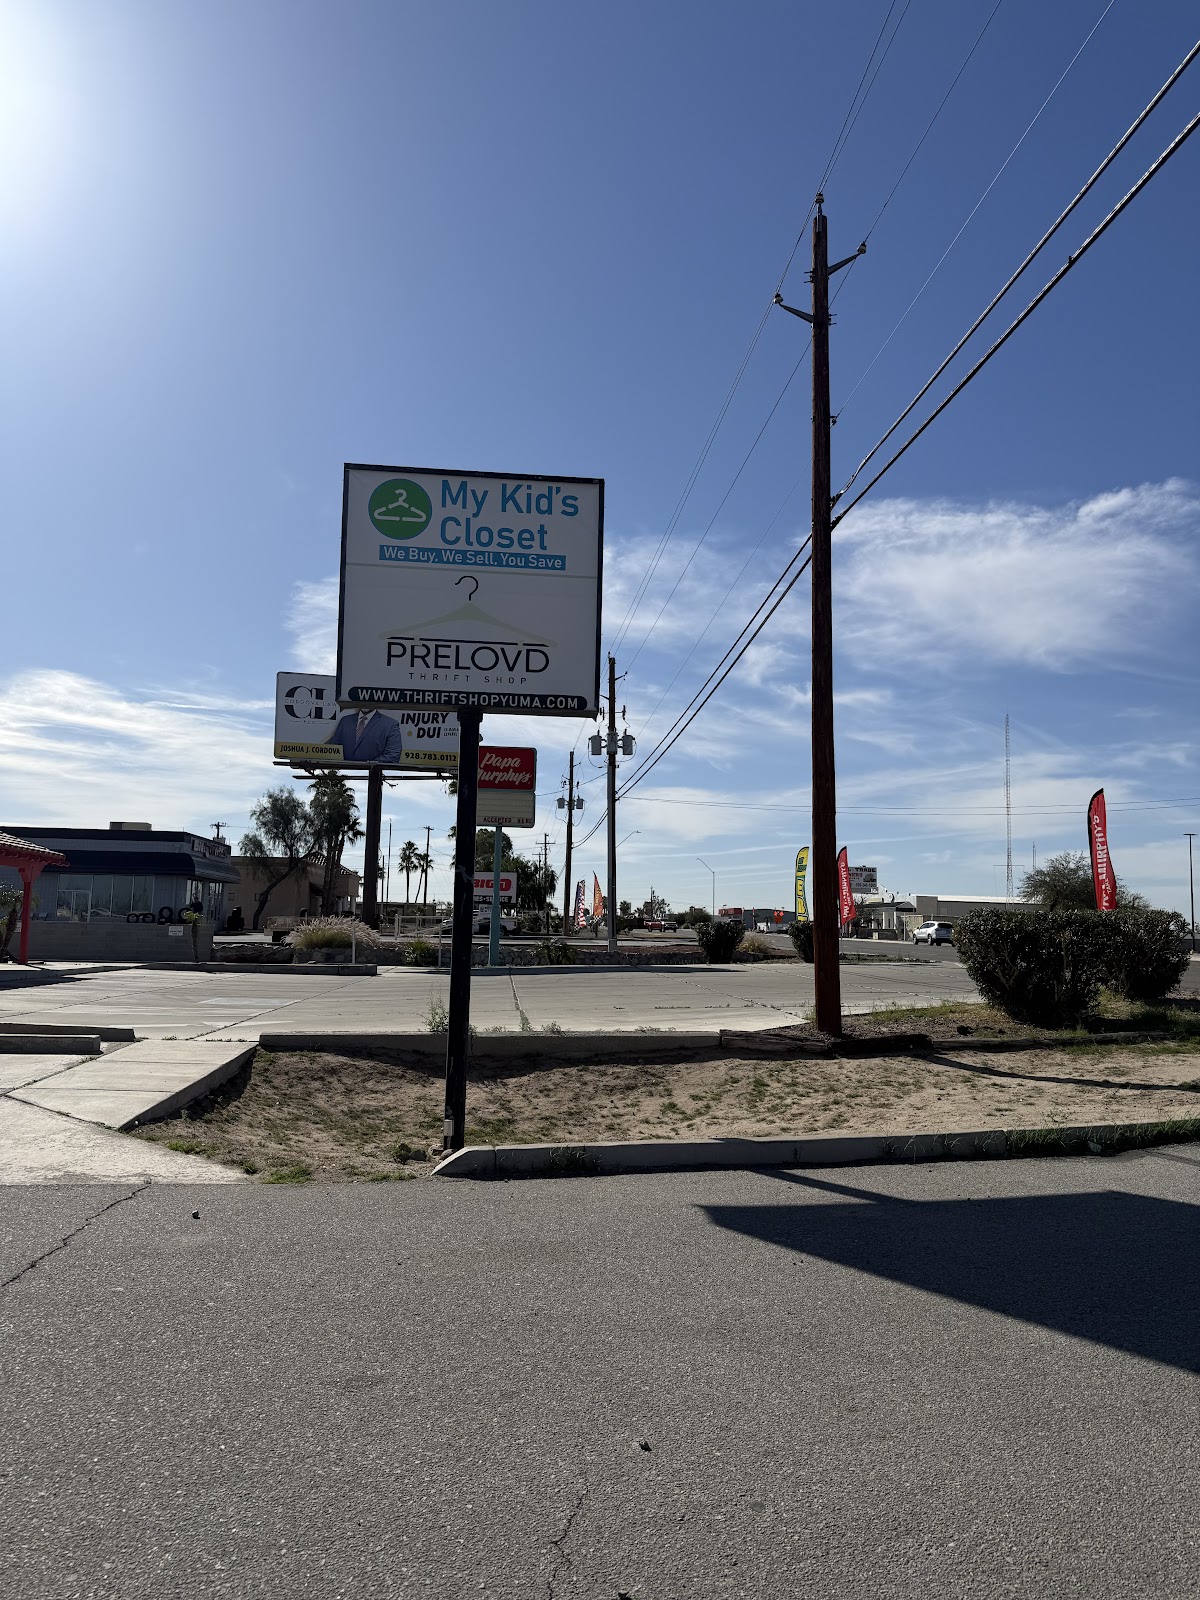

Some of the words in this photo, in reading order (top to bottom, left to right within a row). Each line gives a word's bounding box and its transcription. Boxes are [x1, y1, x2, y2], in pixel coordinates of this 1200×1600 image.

[441, 479, 488, 518] My
[501, 483, 579, 517] Kid's
[440, 516, 548, 551] Closet
[383, 546, 405, 560] We
[409, 547, 438, 563] Buy,
[442, 550, 462, 563] We
[466, 551, 497, 566] Sell,
[500, 553, 525, 567] You
[528, 555, 562, 569] Save
[386, 641, 550, 673] PRELOVD
[408, 672, 471, 683] THRIFT
[484, 675, 527, 685] SHOP
[358, 688, 578, 710] WWW.THRIFTSHOPYUMA.COM
[400, 712, 450, 727] INJURY
[416, 726, 442, 739] DUI
[280, 744, 304, 753] JOSHUA
[305, 746, 311, 754] J.
[311, 746, 341, 755] CORDOVA
[404, 752, 457, 762] 928.783.0112
[480, 752, 521, 770] Papa
